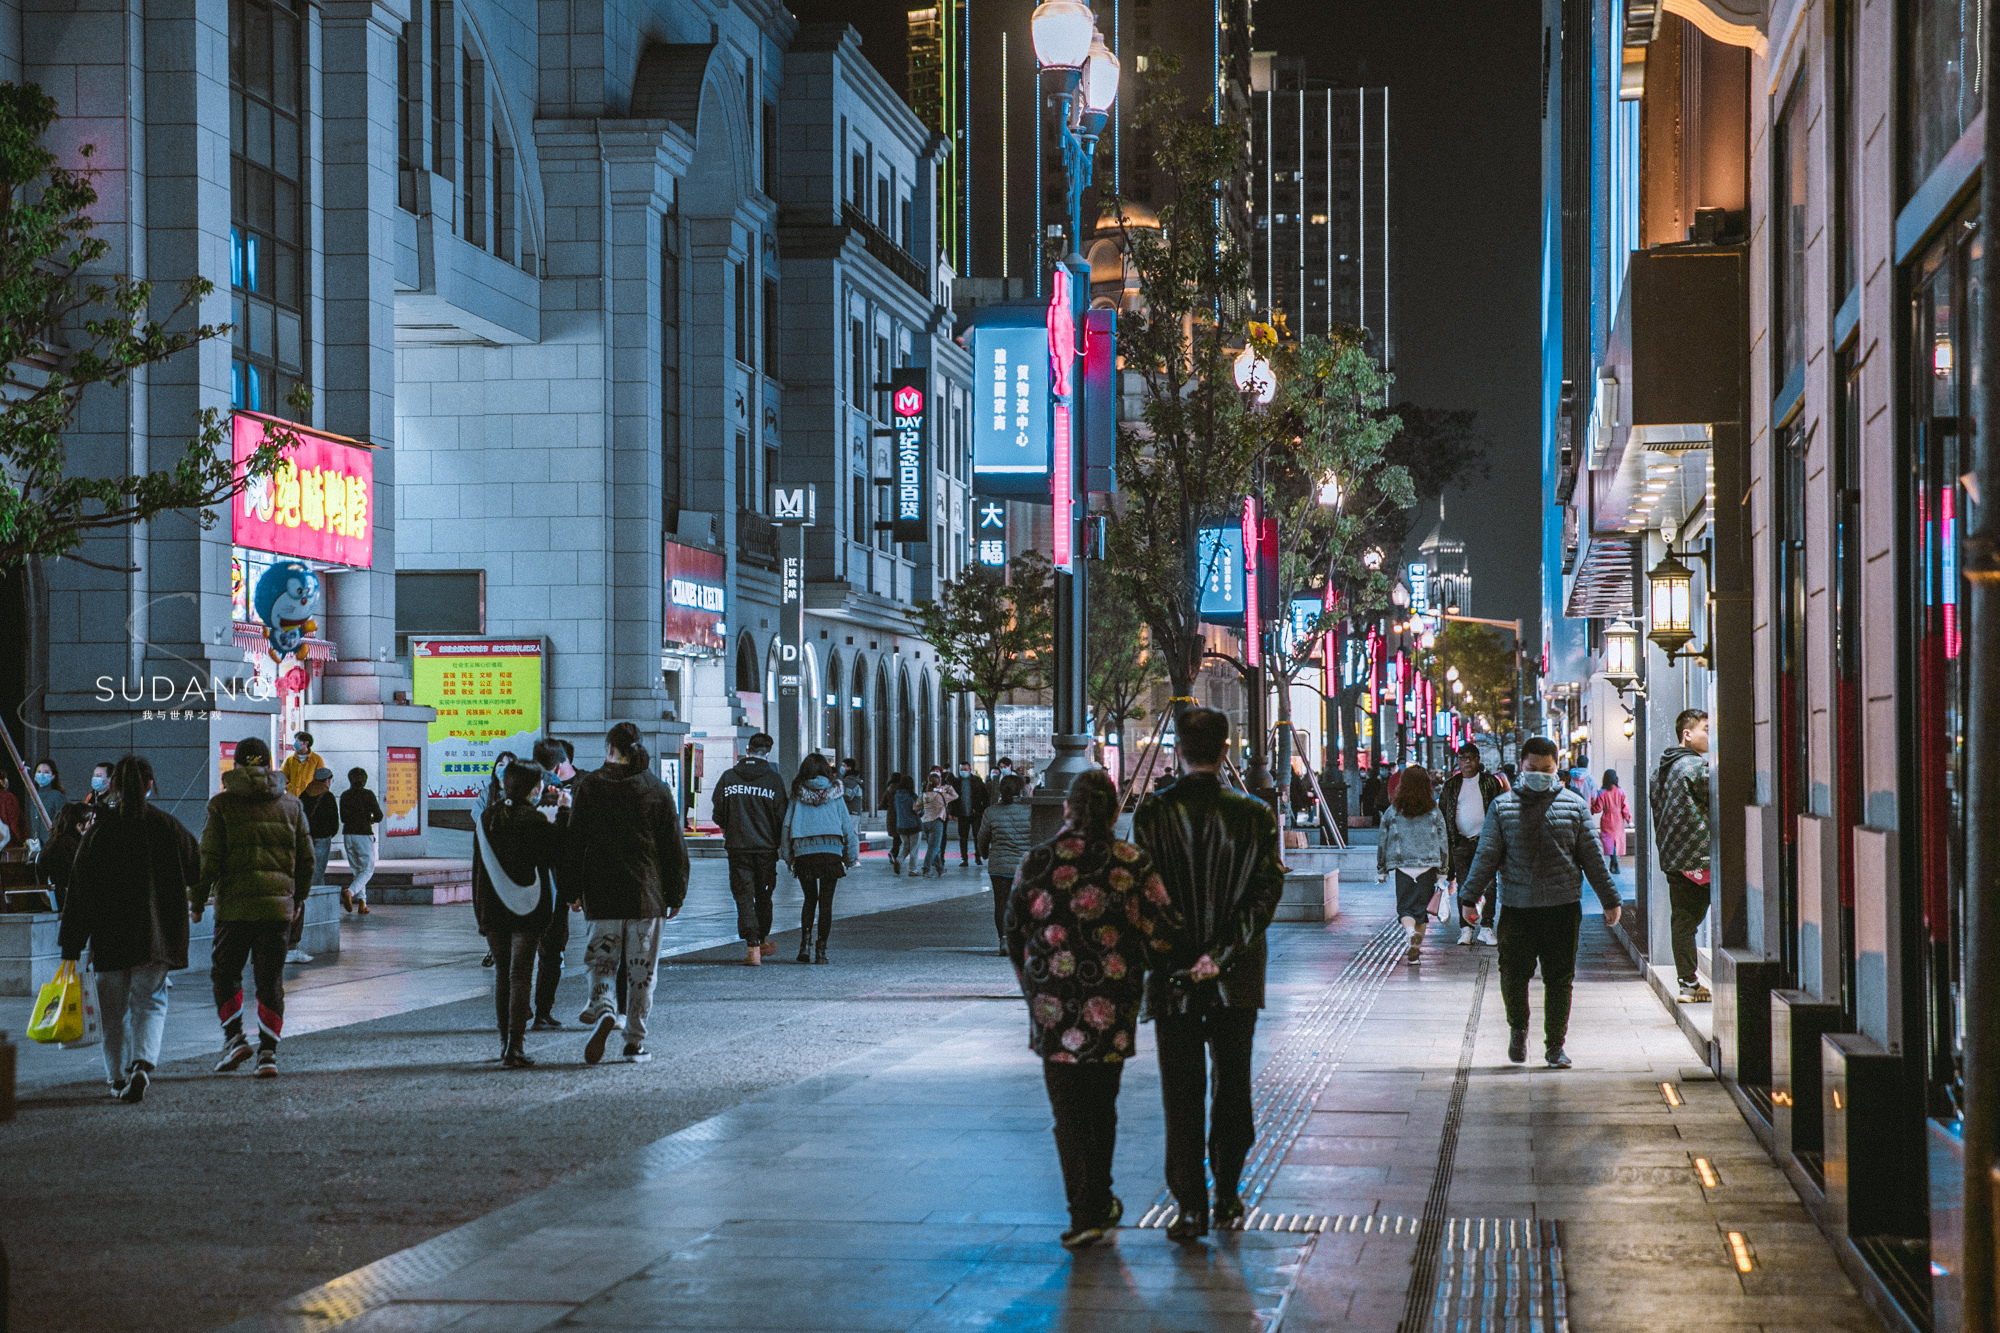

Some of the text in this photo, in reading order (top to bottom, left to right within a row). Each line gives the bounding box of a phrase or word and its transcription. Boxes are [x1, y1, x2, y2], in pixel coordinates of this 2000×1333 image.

[899, 431, 920, 521] 纪念日百货
[788, 557, 798, 599] 江汉路站
[782, 645, 797, 661] D
